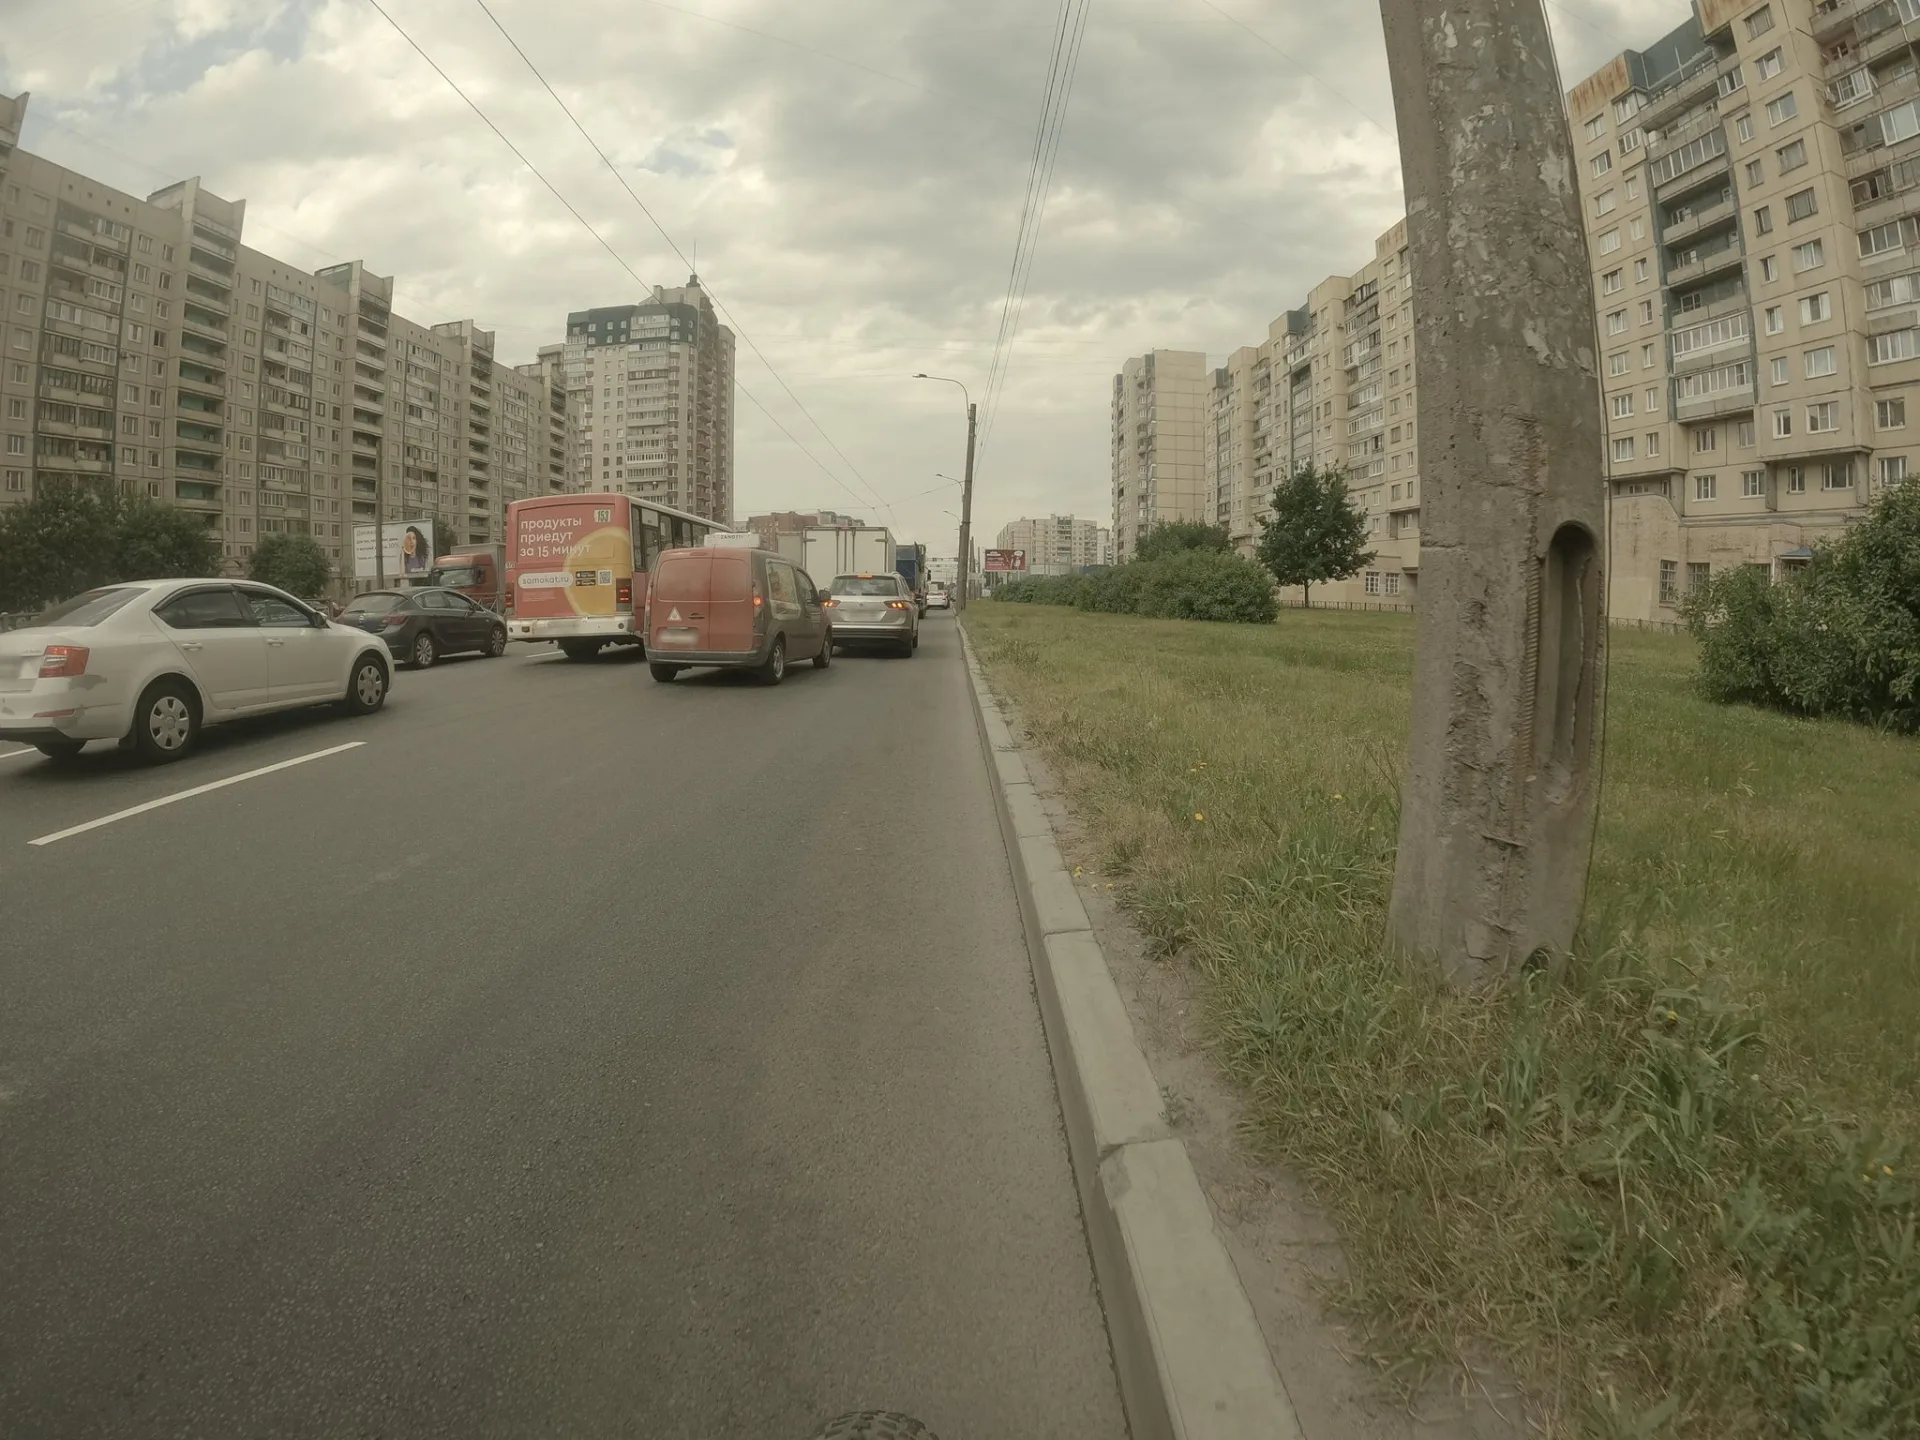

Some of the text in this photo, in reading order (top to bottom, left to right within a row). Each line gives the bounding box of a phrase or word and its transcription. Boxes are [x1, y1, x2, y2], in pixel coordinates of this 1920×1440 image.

[597, 510, 609, 522] 153
[521, 517, 582, 531] продукты
[520, 532, 573, 545] приедут
[520, 545, 590, 557] за 15 минут
[522, 575, 569, 585] samokat.ru
